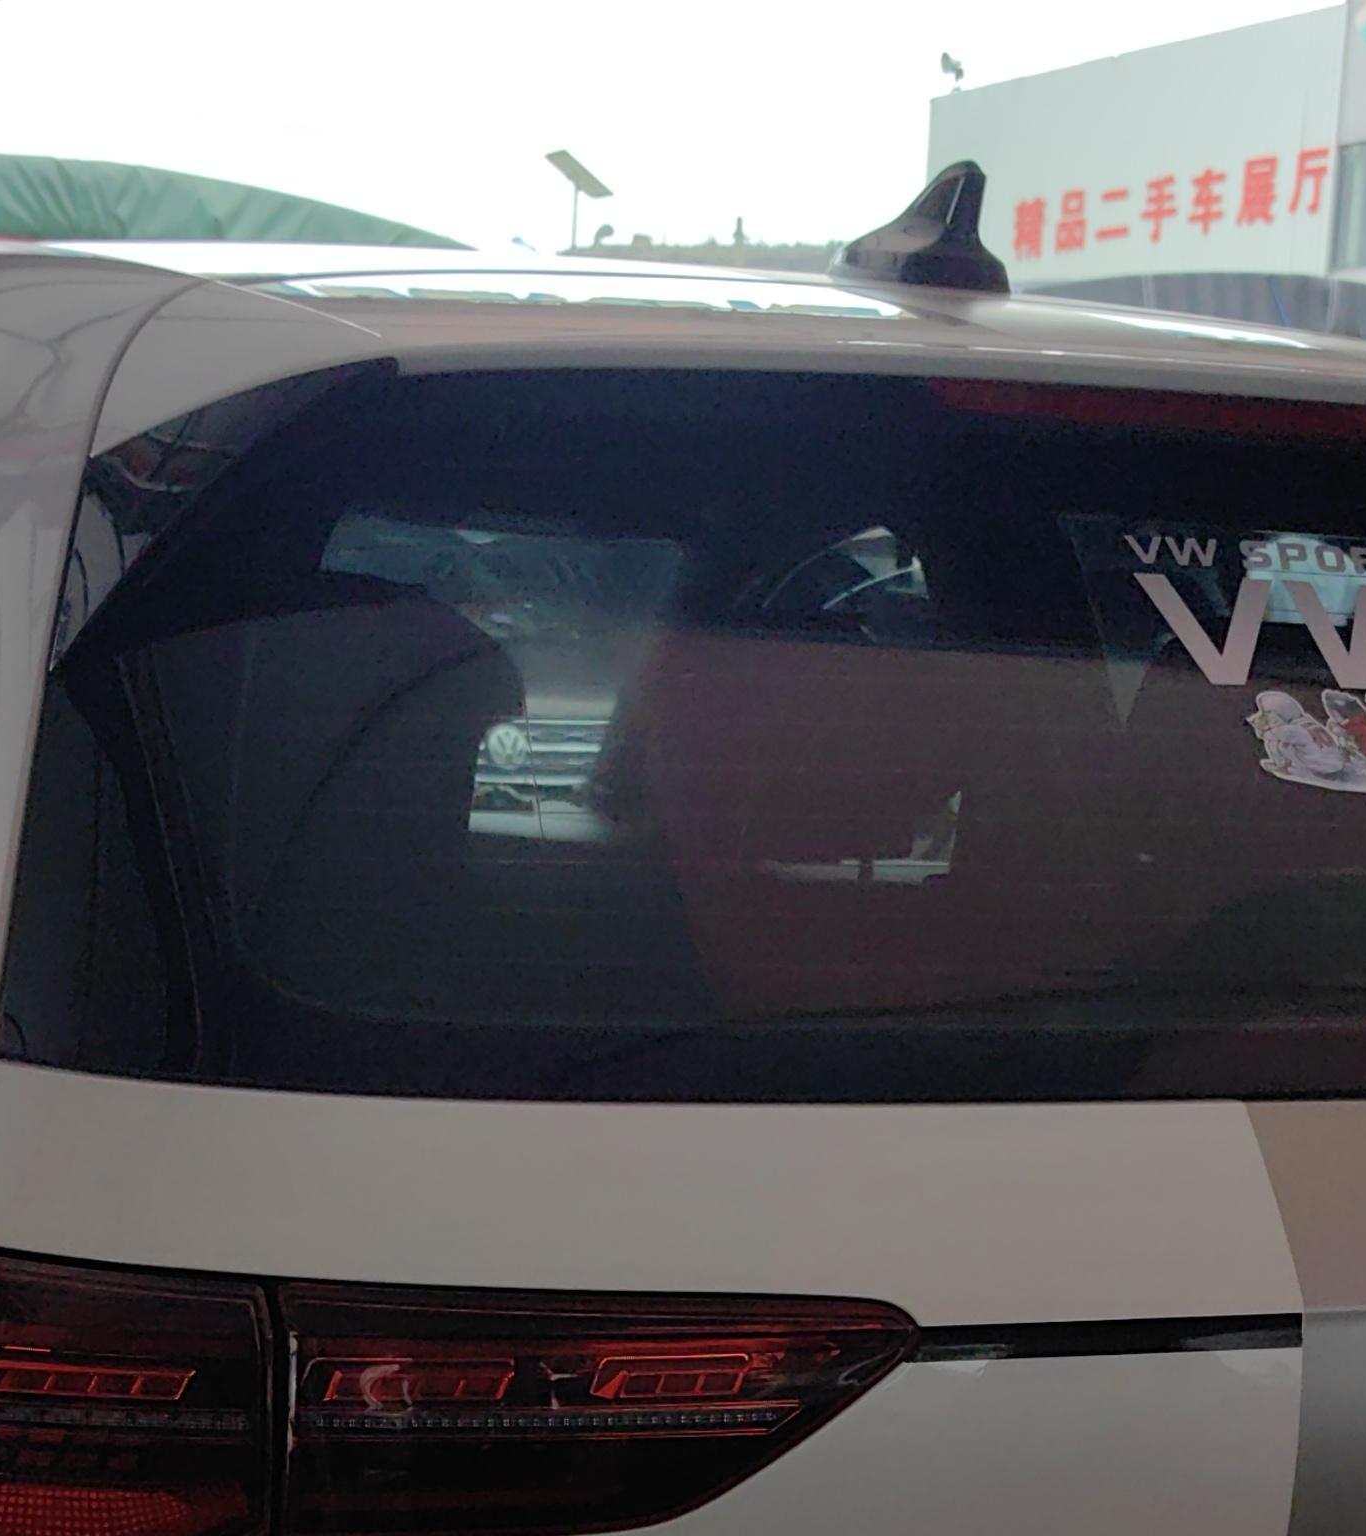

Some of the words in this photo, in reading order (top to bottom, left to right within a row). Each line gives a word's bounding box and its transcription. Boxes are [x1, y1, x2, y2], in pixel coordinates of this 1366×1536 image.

[1012, 146, 1332, 261] 精品二手车展厅
[1123, 534, 1218, 567] VW
